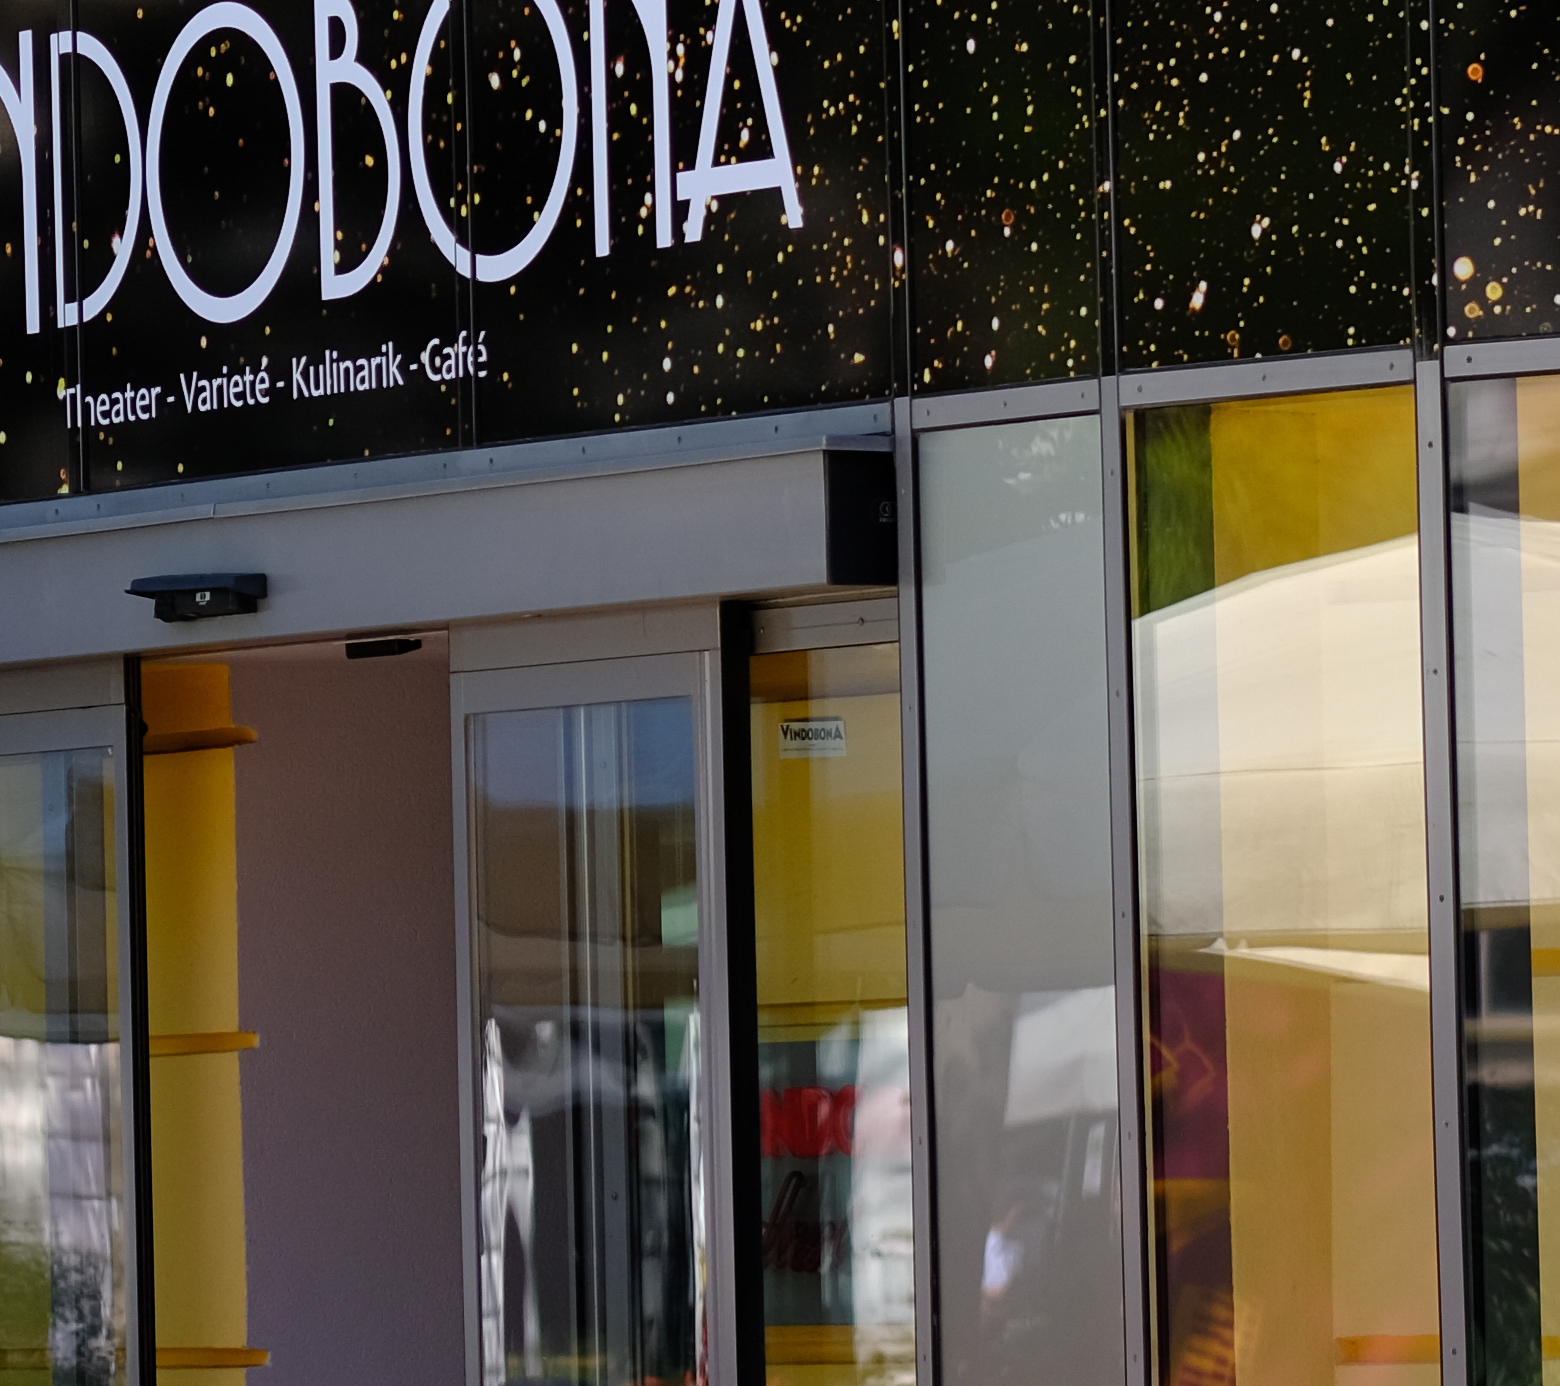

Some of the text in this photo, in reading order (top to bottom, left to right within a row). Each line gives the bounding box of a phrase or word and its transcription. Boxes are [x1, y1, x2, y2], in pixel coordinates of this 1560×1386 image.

[64, 382, 162, 429] Theater
[180, 363, 270, 414] Varieté
[291, 341, 404, 400] Kulinarik
[424, 329, 488, 383] Café
[780, 724, 843, 741] VINDOBONA
